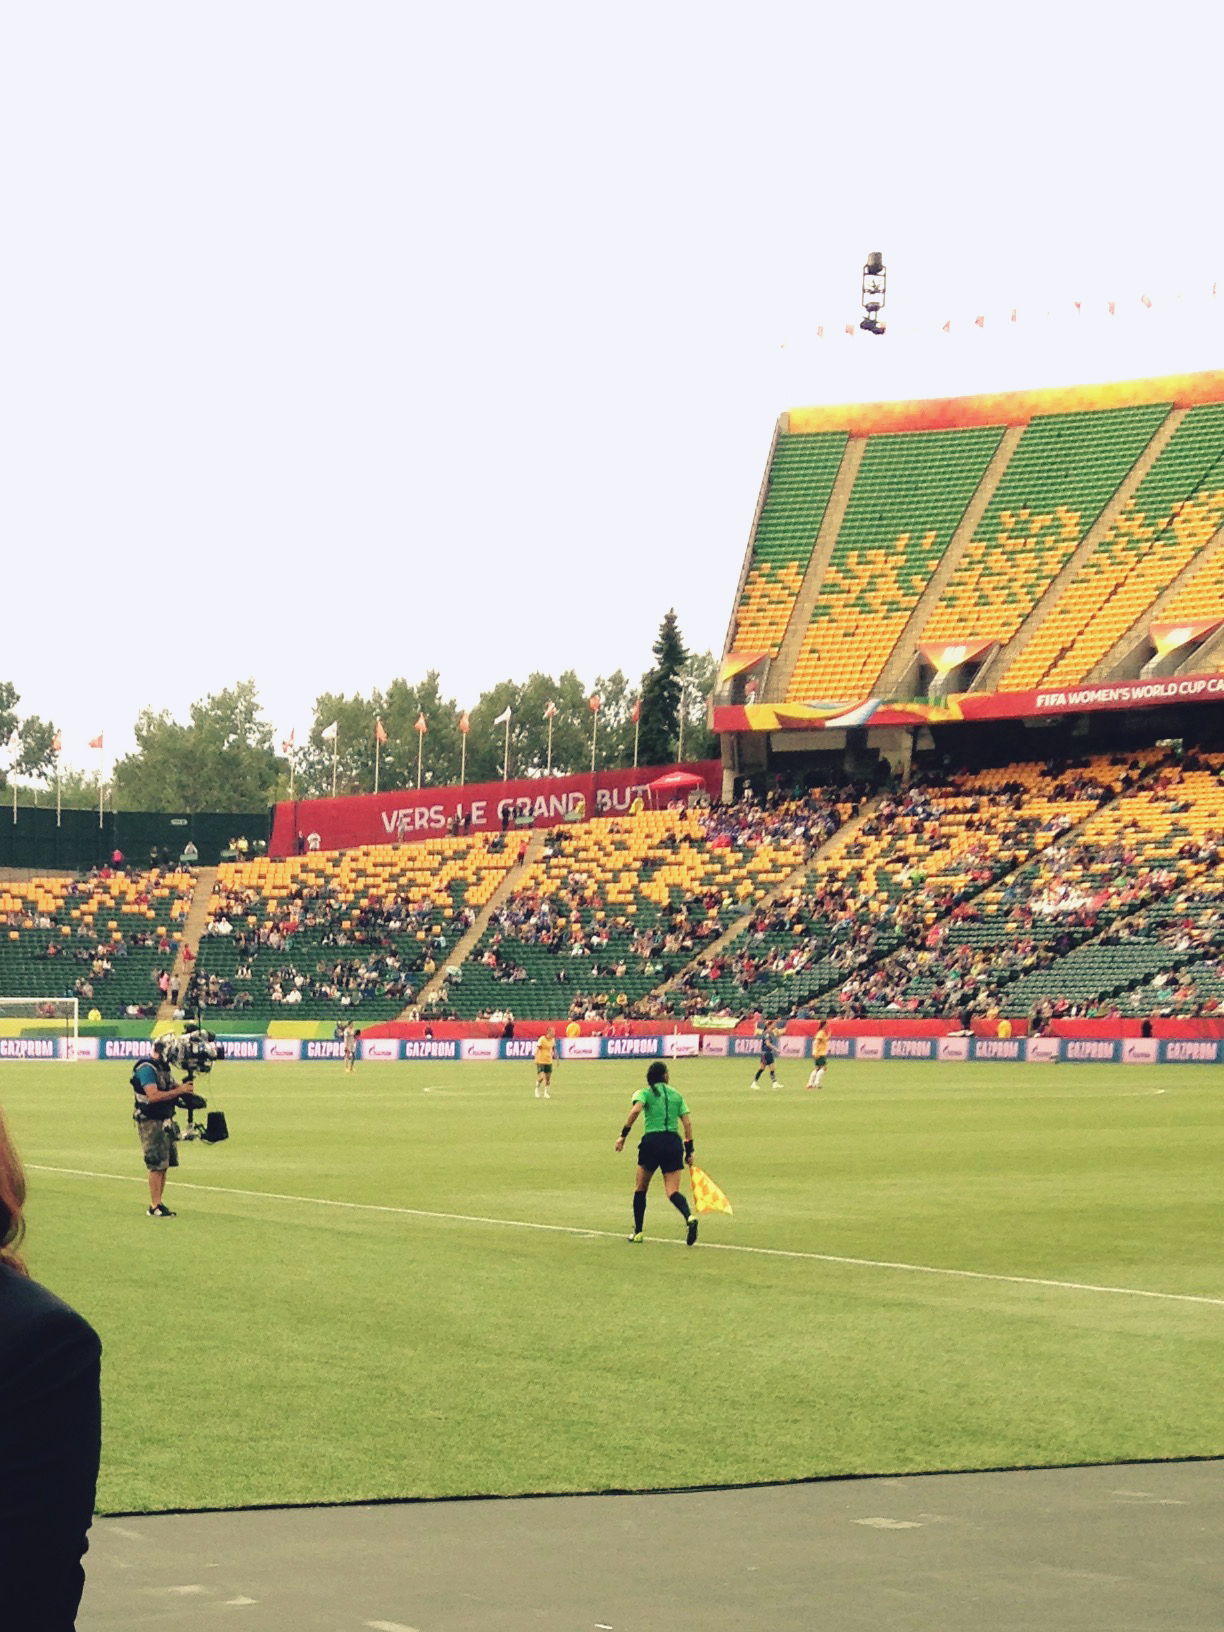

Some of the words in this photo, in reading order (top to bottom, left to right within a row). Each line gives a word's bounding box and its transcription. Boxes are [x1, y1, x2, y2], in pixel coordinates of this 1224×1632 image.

[1036, 692, 1066, 707] FIFA
[1068, 686, 1130, 704] WOMEN'S
[1131, 682, 1177, 699] WORLD
[1178, 680, 1206, 694] CUP
[381, 805, 446, 833] VERS
[455, 800, 487, 825] LE
[0, 1040, 53, 1056] GAZPROM
[307, 1041, 346, 1058] GAZPRO
[405, 1041, 456, 1057] GAZPROM
[607, 1038, 658, 1054] GAZPROM
[891, 1040, 931, 1057] GAZPROM
[976, 1041, 1019, 1058] GAZPROM
[1068, 1041, 1114, 1059] GAZPROM
[1166, 1041, 1218, 1060] GAZPROM
